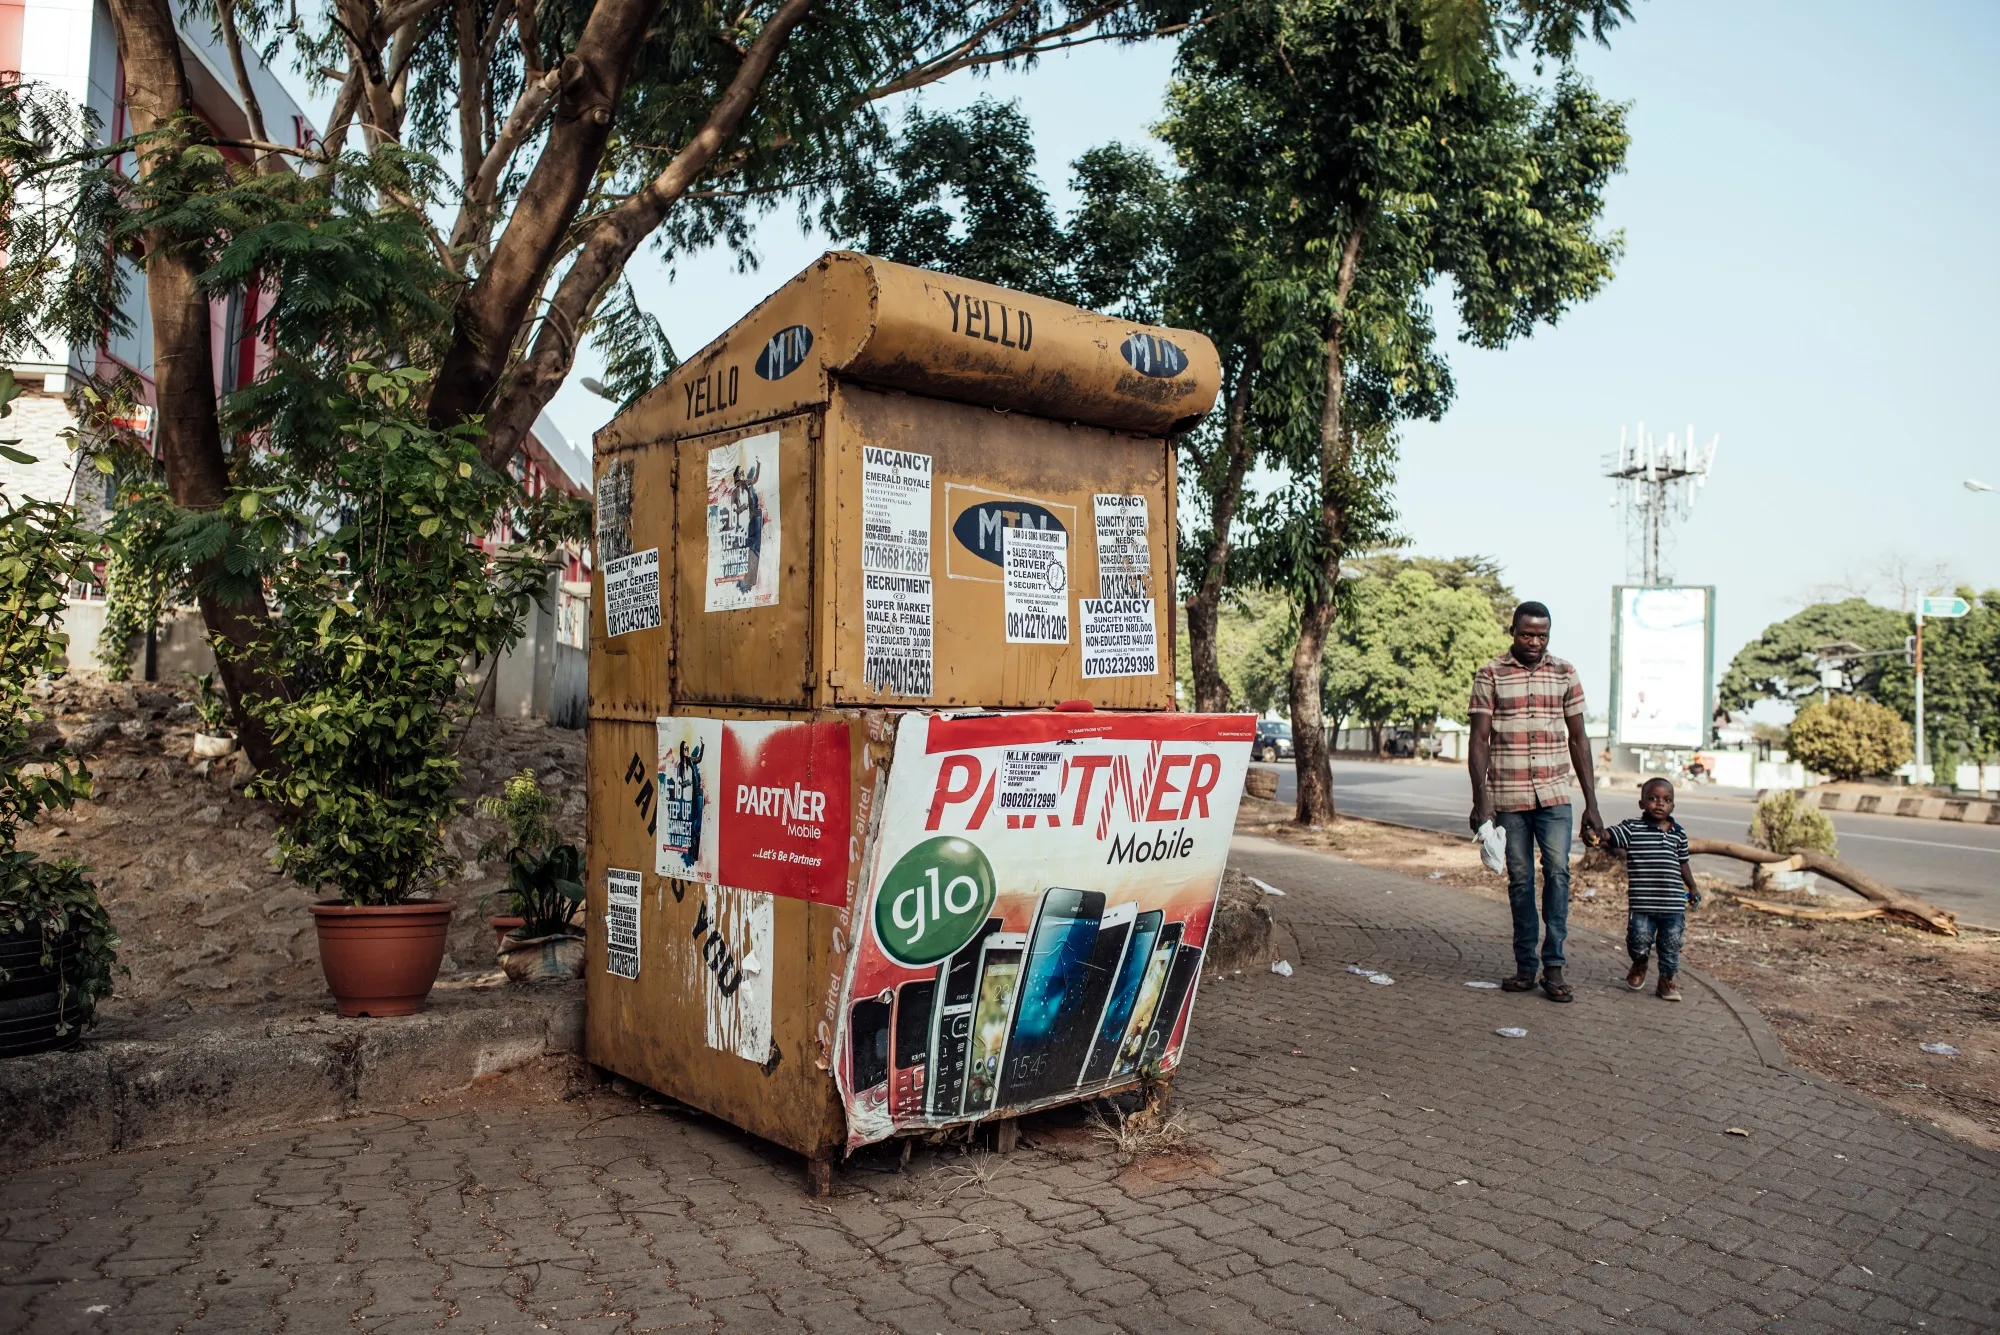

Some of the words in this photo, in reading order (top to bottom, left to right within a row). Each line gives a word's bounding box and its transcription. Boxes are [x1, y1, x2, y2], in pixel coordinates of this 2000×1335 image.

[944, 290, 1032, 351] YELLO
[768, 324, 806, 380] MTN
[1130, 333, 1178, 372] MTN
[684, 365, 738, 420] YELLO
[865, 448, 930, 472] VACANCY
[866, 472, 901, 484] EMERALD
[903, 477, 930, 489] ROYALE
[1096, 496, 1144, 507] VACANCY
[866, 524, 891, 533] EDUCATED
[1097, 516, 1124, 527] SUNCITY
[865, 532, 902, 543] NON-EDUCATED
[1013, 547, 1027, 558] SALES
[1028, 549, 1041, 559] GIRLS
[1043, 550, 1054, 560] BOYS
[1100, 545, 1127, 554] EDUCATED
[606, 559, 629, 575] WEEKLY
[631, 555, 642, 569] PAY
[644, 551, 658, 565] JOB
[864, 546, 929, 572] 07066812687
[1013, 559, 1046, 570] DRIVER
[1100, 554, 1134, 565] NON-EDUCTED
[607, 579, 628, 592] EVENT
[630, 571, 658, 586] CENTER
[1013, 570, 1046, 580] CLEANER
[626, 586, 641, 597] FEMALE
[642, 582, 658, 593] NEEDED
[867, 575, 930, 594] RECRUITMENT
[1014, 581, 1046, 590] SECURITY
[610, 598, 631, 609] N15,000
[633, 591, 658, 603] WEEKLY
[866, 600, 894, 610] SUPER
[897, 602, 930, 613] MARKET
[1085, 600, 1150, 614] VACANCY
[609, 605, 660, 635] 08133432798
[867, 611, 889, 622] MALE
[900, 614, 930, 625] FEMALE
[867, 624, 904, 635] EDUCATED
[909, 627, 930, 637] 70,000
[1008, 612, 1067, 640] 08122781206
[1086, 624, 1124, 633] EDUCATED
[1126, 623, 1152, 634] N80,000
[881, 636, 910, 646] EDUCATED
[1086, 635, 1130, 647] NON-EDUCATED
[875, 647, 890, 656] APPLY
[891, 648, 903, 657] CALL
[912, 649, 924, 658] TEXT
[1085, 656, 1154, 675] 07032329398
[1006, 752, 1029, 760] M.L.M
[1031, 753, 1060, 761] COMPANY
[736, 782, 826, 825] PARTNER
[1000, 793, 1056, 807] 09020212999
[682, 804, 691, 820] UP
[856, 786, 872, 835] airtel
[787, 822, 821, 840] Mobile
[1107, 827, 1194, 865] Mobile
[778, 852, 787, 862] Be
[789, 853, 821, 867] Partners
[627, 872, 640, 882] NEEDED
[610, 882, 638, 897] HILLSIDE
[611, 904, 636, 915] MANAGER
[892, 867, 978, 945] glo
[611, 918, 636, 929] CASHIER
[624, 914, 636, 922] GIRLS
[612, 933, 636, 946] CLEANER
[826, 974, 841, 1021] airtel
